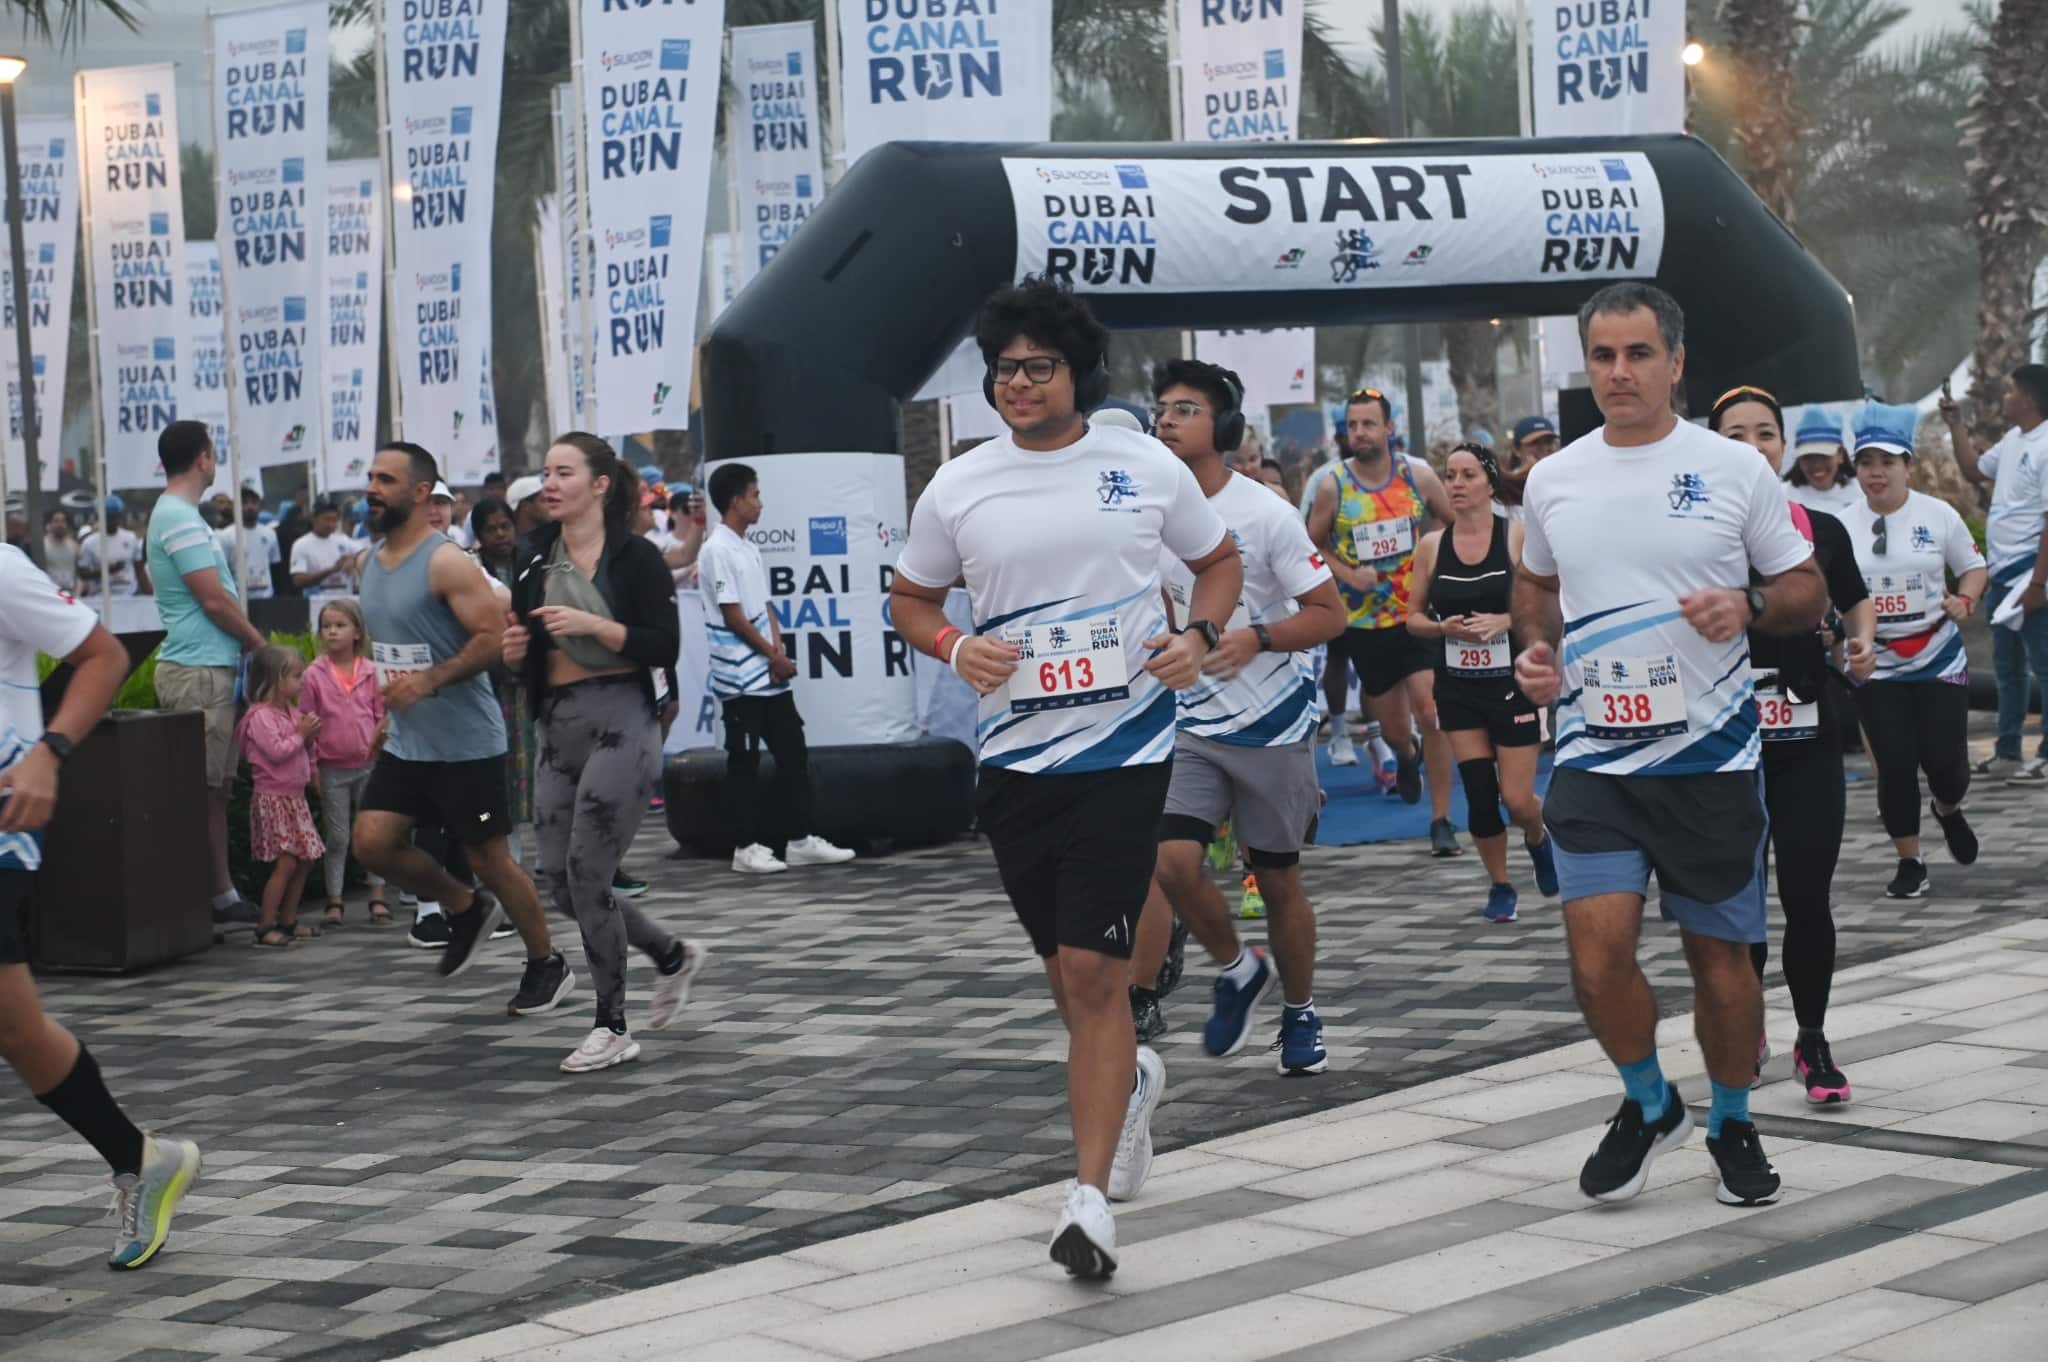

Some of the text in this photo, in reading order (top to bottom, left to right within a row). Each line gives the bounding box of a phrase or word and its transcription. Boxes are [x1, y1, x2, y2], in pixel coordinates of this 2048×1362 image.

[403, 0, 483, 22] DUBAI
[1556, 0, 1649, 33] DUBAI
[403, 19, 480, 46] CANAL
[867, 19, 998, 54] CANAL
[1557, 24, 1649, 61] CANAL
[227, 58, 305, 86] DUBAI
[403, 42, 480, 83] RUN
[750, 81, 806, 102] DUBAI
[868, 51, 1003, 104] RUN
[1557, 51, 1649, 105] RUN
[227, 79, 304, 108] CANAL
[601, 77, 688, 110] DUBAI
[1205, 84, 1288, 117] DUBAI
[227, 101, 305, 140] RUN
[601, 105, 683, 138] CANAL
[751, 102, 806, 122] CANAL
[1207, 111, 1289, 141] CANAL
[104, 121, 164, 142] DUBAI
[753, 121, 808, 152] RUN
[105, 141, 164, 161] CANAL
[408, 140, 470, 169] DUBAI
[602, 131, 681, 181] RUN
[107, 161, 167, 192] RUN
[410, 165, 467, 193] CANAL
[229, 188, 305, 216] DUBAI
[1044, 195, 1156, 218] DUBAI
[1219, 164, 1472, 225] START
[1541, 187, 1639, 211] DUBAI
[232, 210, 303, 237] CANAL
[412, 189, 467, 230] RUN
[1546, 211, 1639, 236] CANAL
[329, 232, 370, 256] RUN
[1047, 220, 1156, 245] CANAL
[111, 239, 171, 260] DUBAI
[234, 231, 305, 269] RUN
[1541, 236, 1640, 274] RUN
[1047, 247, 1156, 285] RUN
[114, 279, 174, 310] RUN
[4, 302, 50, 329] RN
[239, 327, 306, 352] DUBAI
[610, 309, 664, 357] RUN
[243, 349, 303, 375] CANAL
[245, 369, 302, 406] RUN
[118, 403, 178, 433] RUN
[747, 528, 795, 544] KOON
[1372, 537, 1398, 557] 292
[770, 564, 849, 596] BAI
[770, 597, 850, 629] NAL
[1875, 594, 1907, 614] 565
[1090, 626, 1118, 636] DUBAI
[1092, 638, 1119, 651] RUN
[1017, 649, 1035, 660] UN
[1460, 648, 1491, 667] 293
[1647, 663, 1675, 674] DUBAI
[1039, 657, 1095, 693] 613
[1584, 678, 1601, 689] RUN
[1649, 675, 1678, 688] RUN
[1603, 693, 1652, 723] 338
